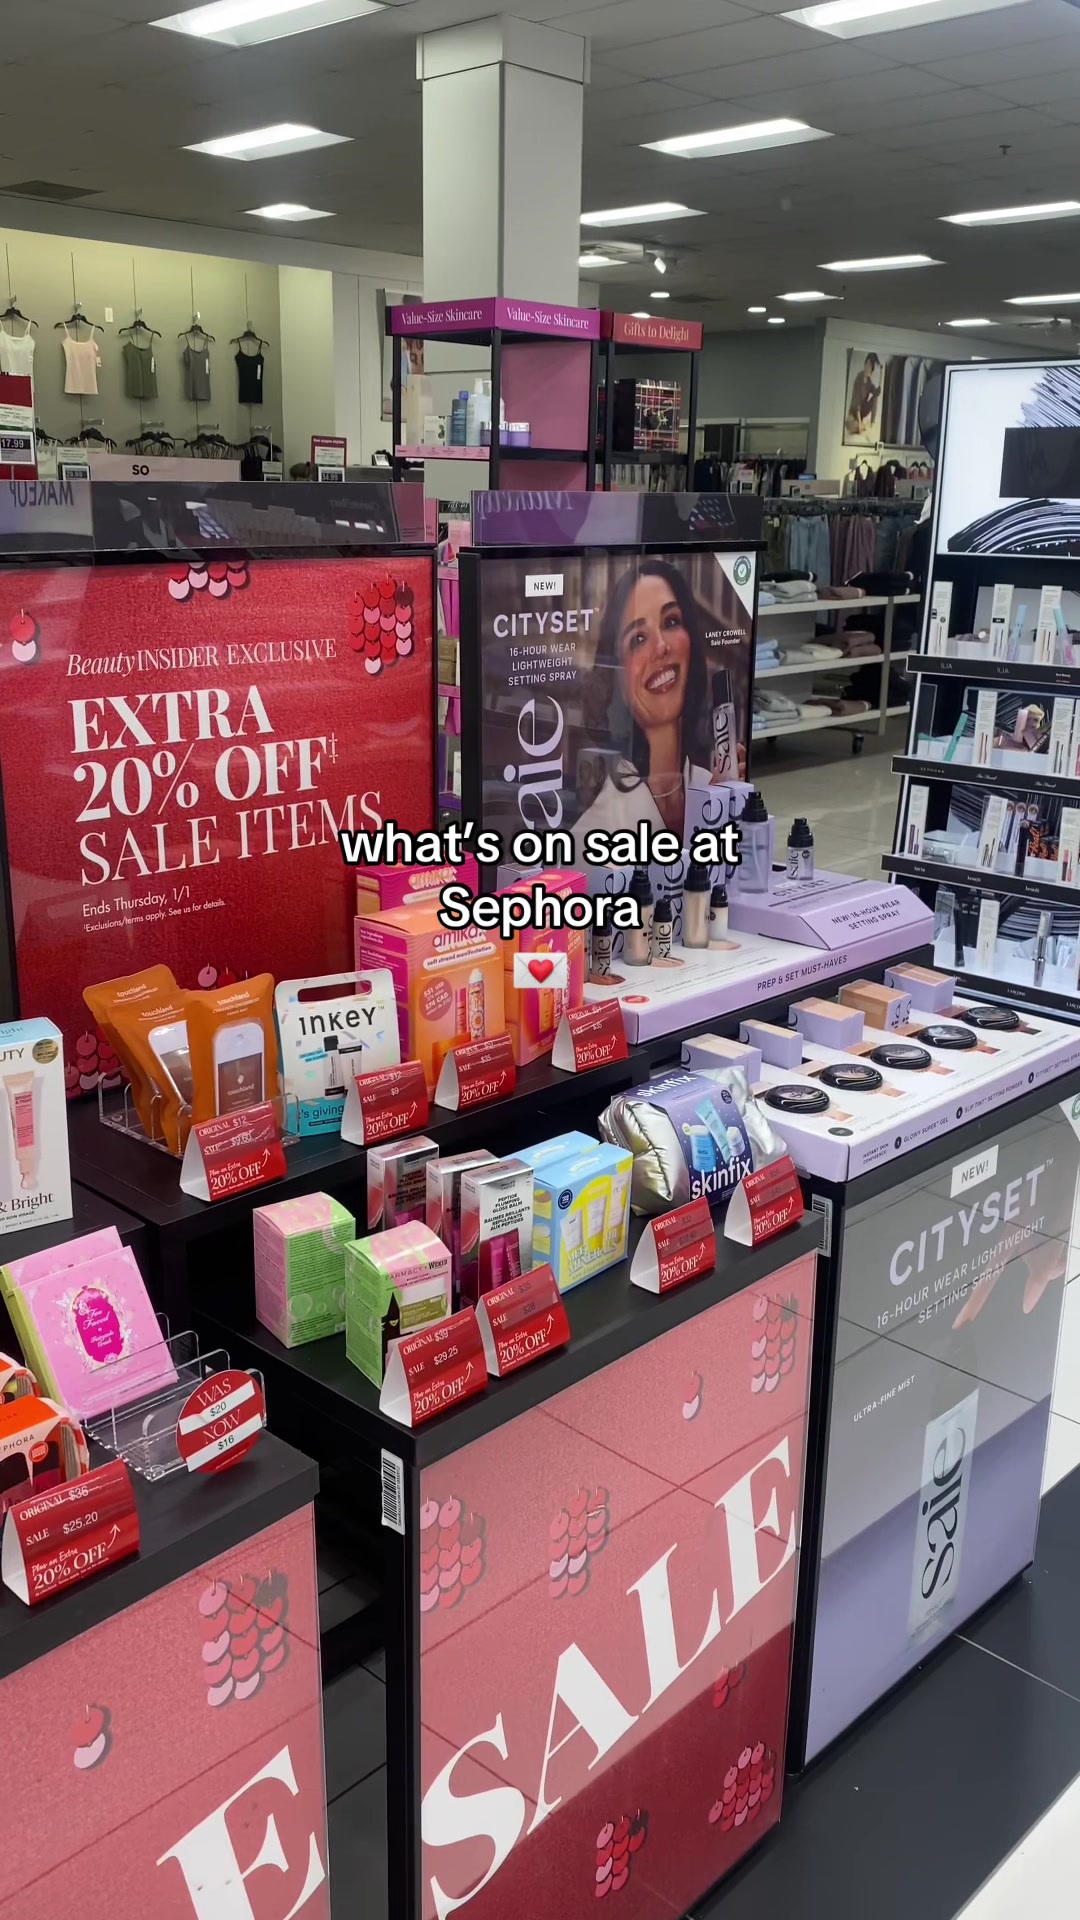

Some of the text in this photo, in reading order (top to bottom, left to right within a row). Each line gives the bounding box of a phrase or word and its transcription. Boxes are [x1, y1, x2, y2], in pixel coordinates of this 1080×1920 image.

[401, 308, 483, 325] Value-Size Skincare
[506, 307, 589, 330] Value-Size Skincare
[623, 323, 690, 342] Gifts to Delight
[132, 465, 149, 476] SO
[533, 581, 556, 591] NEW!
[705, 629, 746, 638] LANEY CROWELL
[721, 637, 741, 646] Founder
[227, 638, 337, 665] EXCLUSIVE
[509, 642, 576, 657] 16-HOUR WEAR
[512, 656, 573, 672] LIGHTWEIGHT
[508, 670, 577, 686] SETTING SPRAY
[67, 684, 275, 754] EXTRA
[503, 695, 564, 830] aie
[73, 742, 200, 823] 20%
[79, 791, 383, 886] SALE ITEMS
[82, 885, 191, 918] Ends Thursday, 1/1
[145, 898, 226, 923] apply. See us for details.
[831, 899, 901, 925] NEW! 16-HOUR WEAR
[848, 910, 901, 930] SETTING SPRAY
[757, 954, 848, 991] PREP & SET MUST-HAVES
[117, 983, 147, 998] touchland
[217, 991, 250, 1006] touchland
[141, 1004, 174, 1018] touchland
[576, 1044, 611, 1064] 20% OFF
[362, 1086, 400, 1104] SALE $9
[461, 1087, 481, 1102] 20%
[481, 1080, 500, 1096] OFF
[637, 1075, 697, 1098] skinfix
[1005, 1080, 1024, 1095] POWDER
[198, 1115, 248, 1137] ORIGINAL $12
[366, 1120, 388, 1136] 20%
[389, 1112, 410, 1129] OFF
[903, 1116, 949, 1143] GLOWY GEL
[210, 1170, 238, 1190] 20%
[238, 1161, 262, 1180] OFF
[691, 1156, 752, 1201] skinfix
[960, 1160, 990, 1184] NEW!
[11, 1192, 54, 1210] Bright
[492, 1200, 523, 1214] GLOSS BALM
[495, 1197, 521, 1208] PLUMPING
[754, 1207, 789, 1236] 20% OFF
[661, 1254, 699, 1283] 20% OFF
[876, 1215, 1046, 1329] 16-HOUR WEAR LIGHTWEIGHT
[486, 1287, 516, 1307] ORIGINAL
[918, 1259, 1007, 1324] SETTING SPRAY
[492, 1312, 509, 1327] SALE
[402, 1327, 449, 1355] ORIGINAL $39
[500, 1328, 547, 1364] 20% OFF
[408, 1345, 459, 1377] SALE $29.25
[196, 1377, 232, 1407] WAS
[414, 1376, 465, 1415] 20% OFF
[853, 1374, 916, 1423] ULTRA-FINE MIST
[210, 1401, 227, 1417] $20
[203, 1409, 241, 1445] NOW
[217, 1434, 235, 1450] $16
[19, 1494, 65, 1521] ORIGINAL
[921, 1427, 967, 1600] saie
[25, 1510, 99, 1546] SALE $25.20
[33, 1561, 72, 1591] 20%
[73, 1541, 108, 1570] OFF
[58, 1547, 79, 1561] Extra
[421, 1435, 797, 1920] SALE
